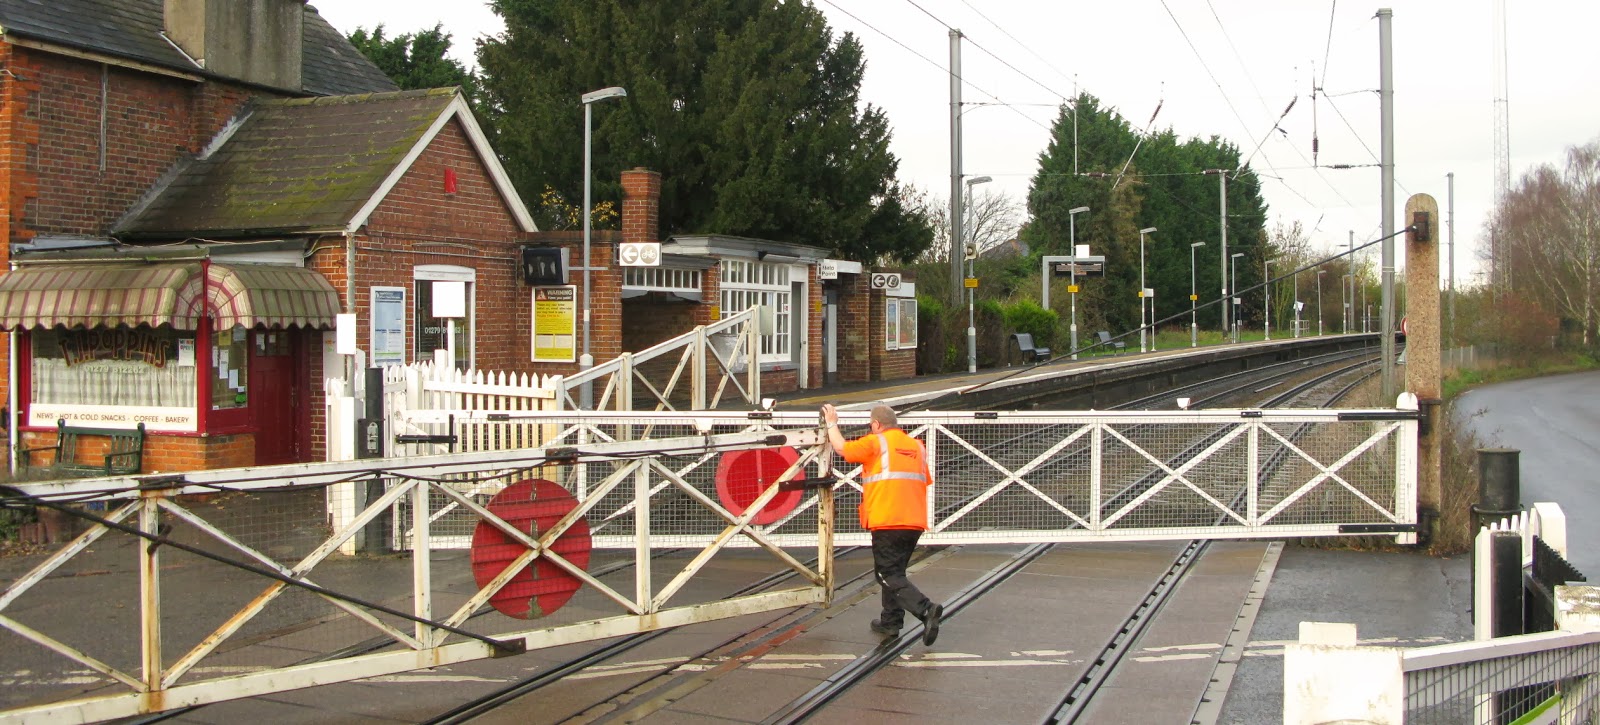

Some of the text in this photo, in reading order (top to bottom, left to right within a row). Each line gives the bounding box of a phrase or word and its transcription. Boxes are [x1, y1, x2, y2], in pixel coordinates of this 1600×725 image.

[424, 326, 440, 334] 01279
[101, 414, 126, 422] SNACKS
[133, 415, 159, 423] COFFEE
